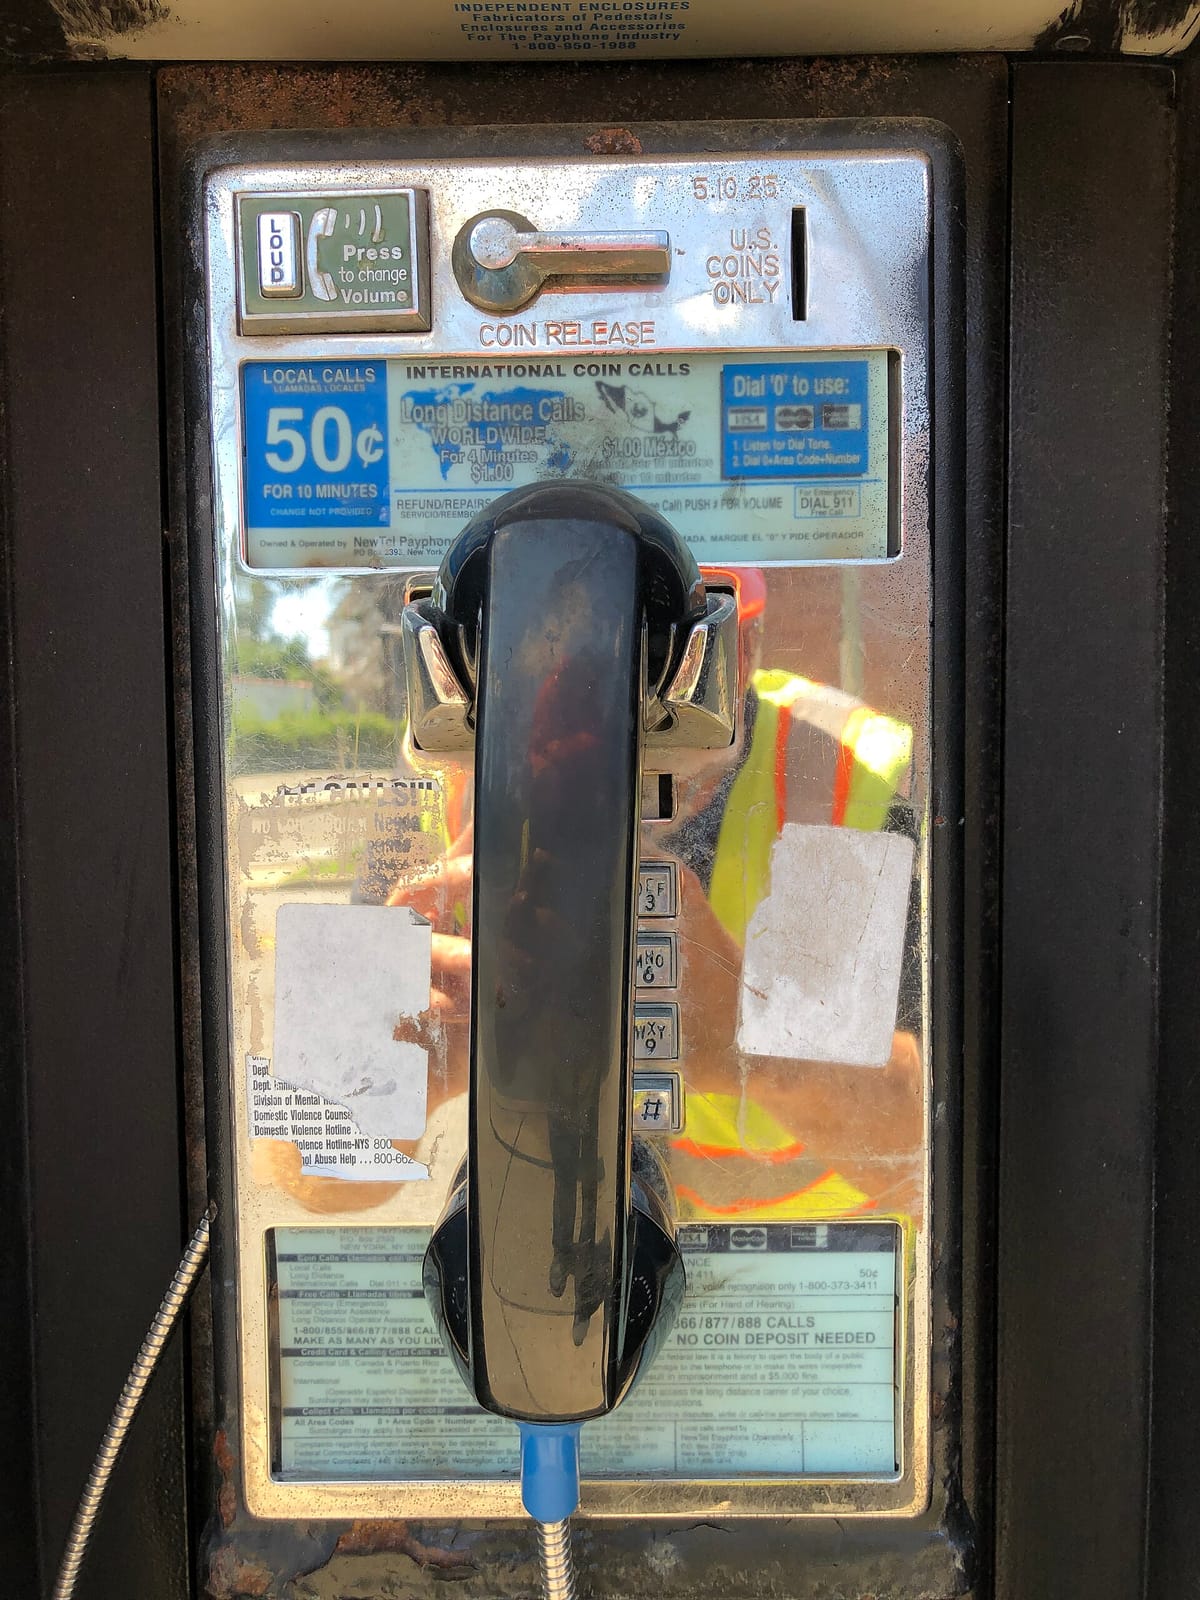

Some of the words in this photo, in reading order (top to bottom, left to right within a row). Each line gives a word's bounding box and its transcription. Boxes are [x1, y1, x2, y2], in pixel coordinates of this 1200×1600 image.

[454, 2, 571, 12] INDEPENDENT
[579, 2, 690, 11] ENCLOSURES
[472, 13, 566, 22] Fabricators
[572, 12, 586, 21] of
[594, 12, 672, 20] Pedestals
[461, 23, 548, 32] Enclosures
[555, 22, 583, 31] and
[590, 22, 686, 30] Accessories
[468, 33, 492, 41] For
[500, 32, 526, 41] The
[534, 32, 608, 42] Payphone
[616, 32, 680, 41] Industry
[730, 228, 778, 251] U.S.
[270, 218, 284, 283] LOUD
[343, 244, 402, 261] Press
[706, 254, 780, 278] COINS
[338, 266, 354, 282] to
[358, 265, 408, 284] change
[340, 288, 408, 304] Volume
[713, 280, 780, 304] ONLY
[479, 323, 537, 348] COIN
[546, 321, 656, 346] RELEASE
[263, 368, 318, 384] LOCAL
[322, 368, 376, 384] CALLS
[406, 365, 566, 379] INTERNATIONAL
[573, 364, 622, 377] COIN
[628, 364, 691, 376] CALLS
[734, 374, 766, 397] Dial
[792, 375, 809, 396] to
[814, 376, 850, 395] use:
[400, 400, 447, 426] Long
[452, 398, 534, 424] Distance
[538, 398, 586, 422] Calls
[265, 406, 384, 474] 50¢
[432, 426, 547, 446] WORLDWIDE
[440, 450, 465, 464] For
[480, 450, 538, 463] Minutes
[470, 464, 514, 482] $1.00
[264, 484, 292, 498] FOR
[297, 484, 312, 498] 10
[316, 484, 378, 498] MINUTES
[685, 499, 710, 511] PUSH
[800, 498, 830, 509] DIAL
[833, 496, 853, 508] 911
[270, 508, 306, 516] CHANGE
[400, 510, 477, 519] SERVICIO/REEMBO
[400, 536, 453, 549] Payphon
[646, 894, 656, 912] 3
[642, 966, 655, 984] 6
[646, 1038, 656, 1056] 9
[254, 1094, 282, 1106] Division
[285, 1094, 292, 1106] of
[294, 1094, 320, 1106] Mental
[254, 1110, 288, 1122] Domestic
[290, 1110, 322, 1121] Violence
[324, 1110, 352, 1120] Counse
[254, 1125, 288, 1136] Domestic
[291, 1124, 322, 1136] Violence
[326, 1124, 350, 1136] Hotline
[326, 1138, 370, 1150] Hotline-NYS
[315, 1154, 338, 1165] Abuse
[340, 1154, 356, 1166] Help
[767, 1316, 816, 1328] CALLS
[414, 1326, 438, 1335] CAL
[294, 1336, 326, 1345] MAKE
[328, 1336, 342, 1345] AS
[346, 1336, 377, 1345] MANY
[380, 1336, 394, 1345] AS
[399, 1336, 420, 1345] YOU
[676, 1333, 698, 1346] NO
[703, 1333, 740, 1346] COIN
[744, 1332, 810, 1345] DEPOSIT
[814, 1332, 876, 1344] NEEDED
